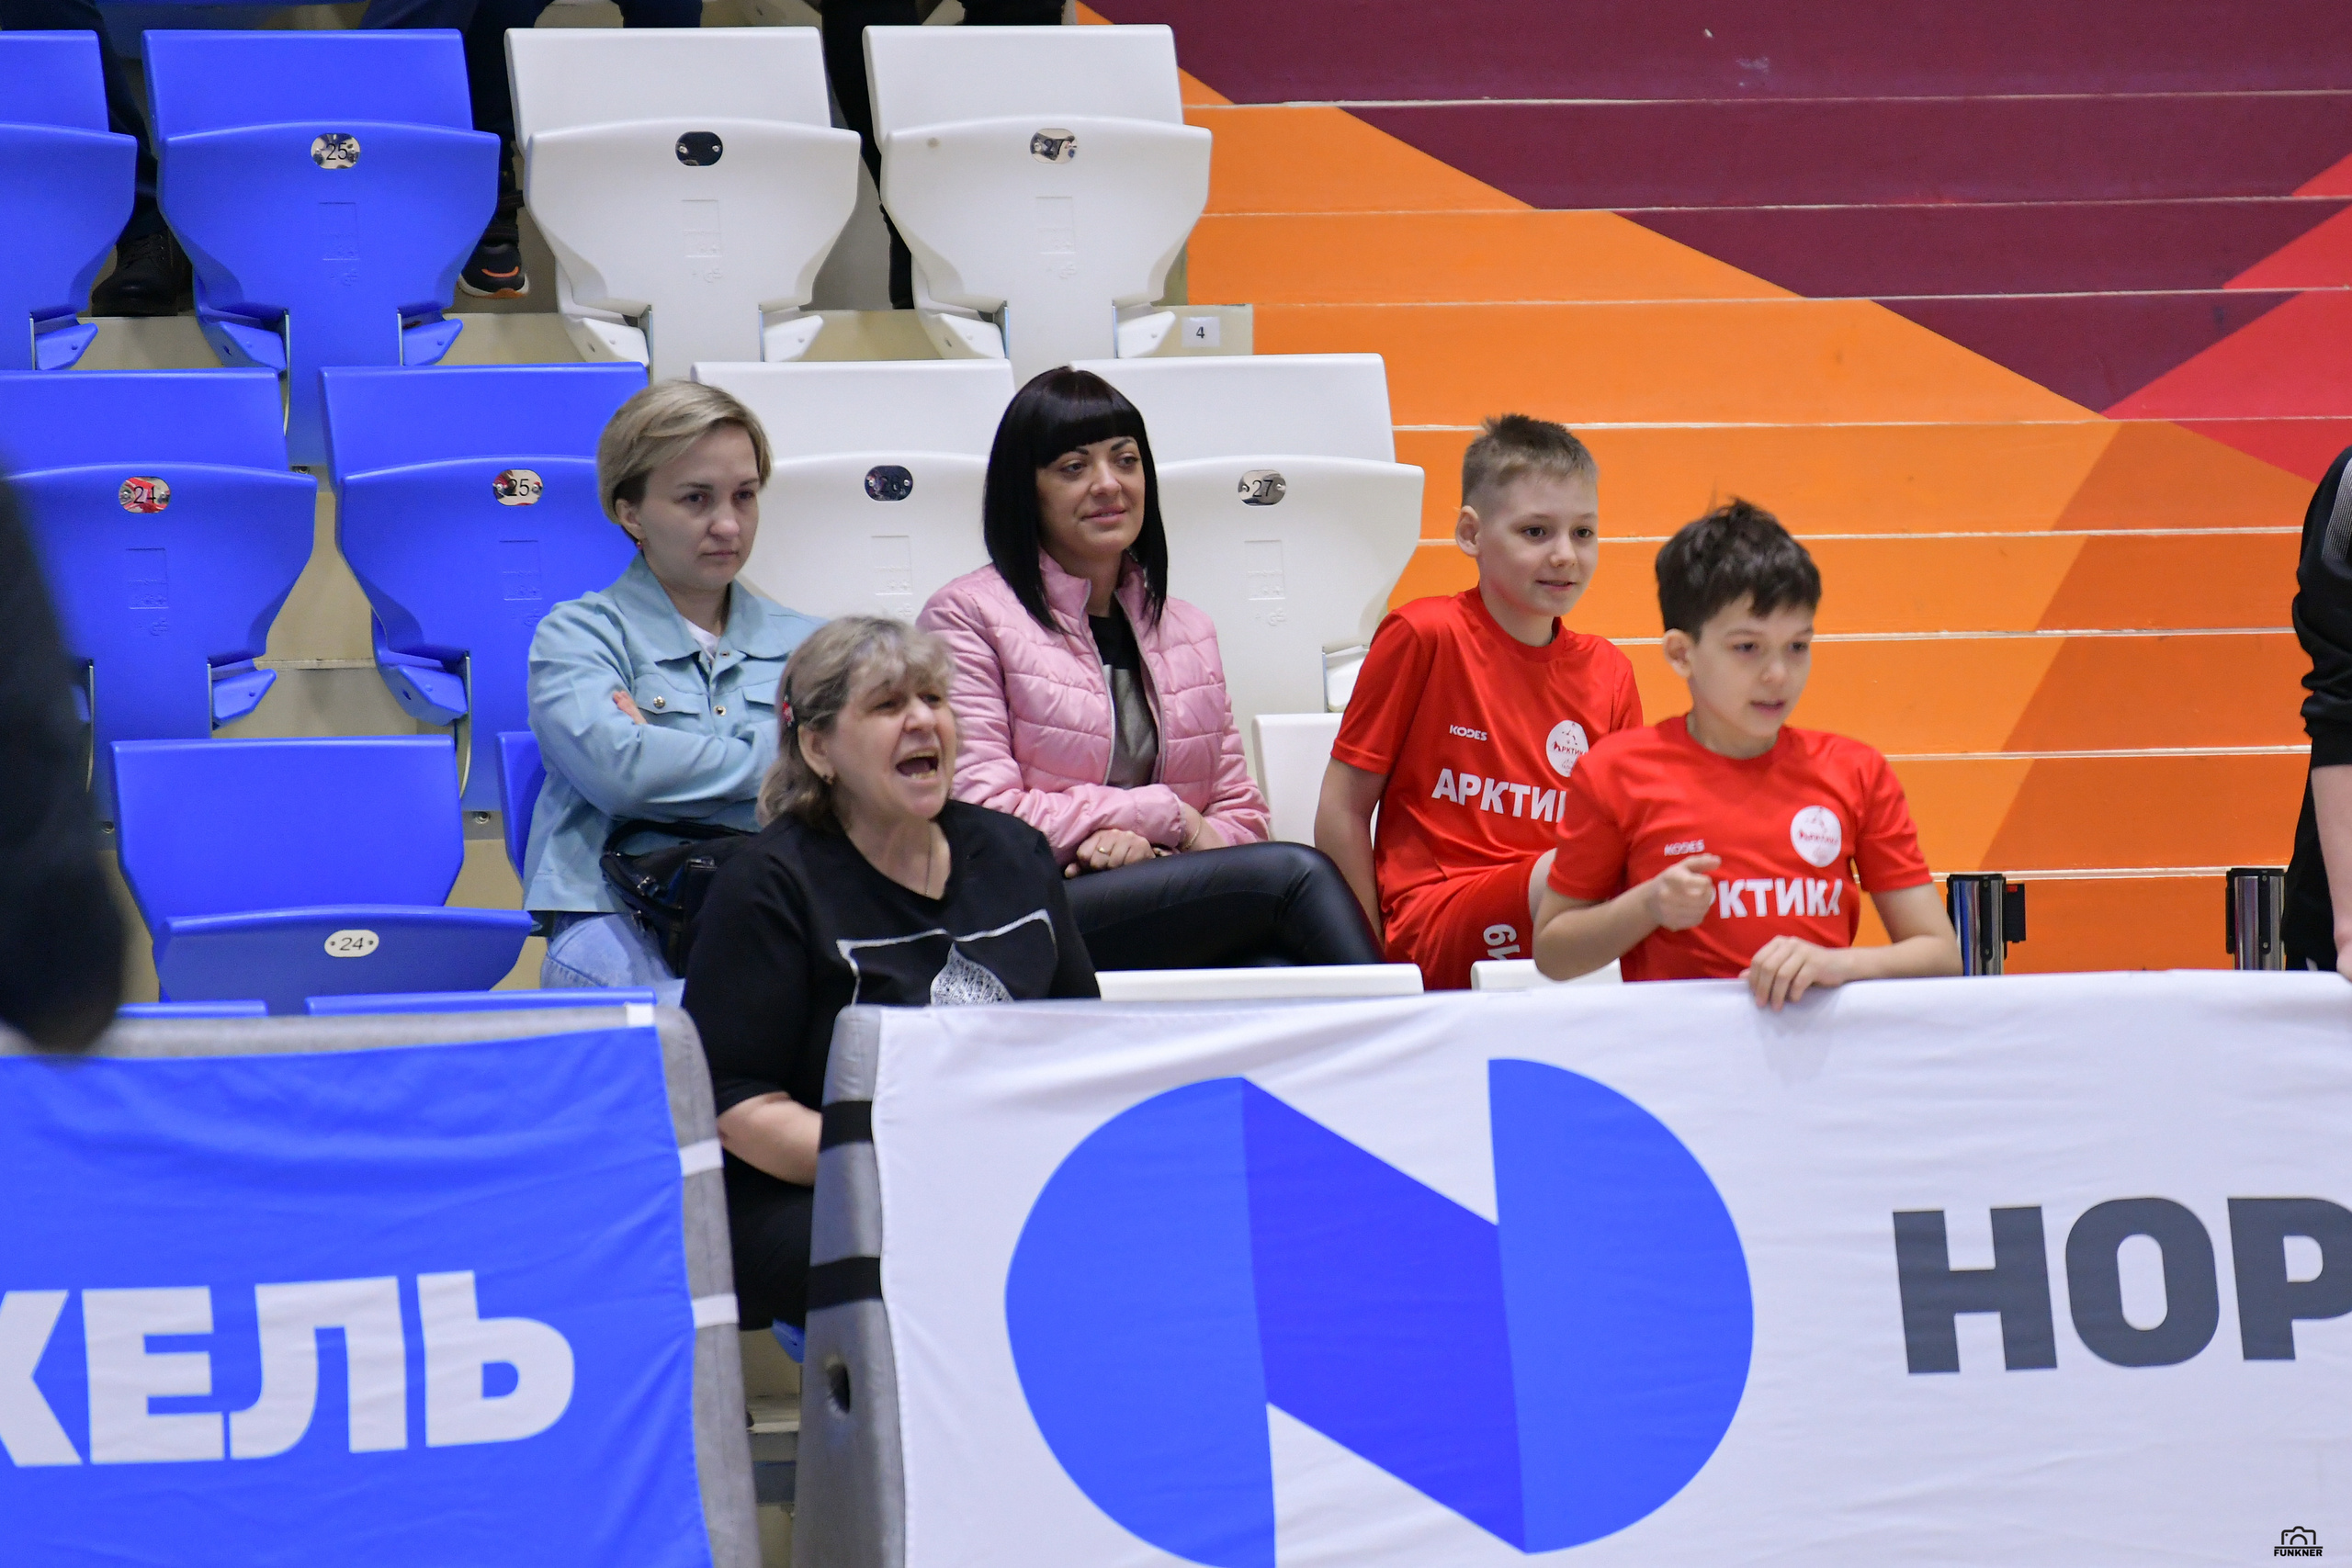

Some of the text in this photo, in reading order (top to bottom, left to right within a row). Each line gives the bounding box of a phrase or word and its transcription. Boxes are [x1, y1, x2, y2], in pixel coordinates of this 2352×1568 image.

[326, 142, 348, 161] 25
[1044, 138, 1064, 156] 27
[1195, 325, 1205, 339] 4
[133, 485, 156, 504] 24
[507, 478, 530, 497] 25
[1251, 479, 1273, 498] 27
[1449, 724, 1488, 742] KODES
[1710, 877, 1843, 919] КТИКА
[339, 937, 364, 951] 24
